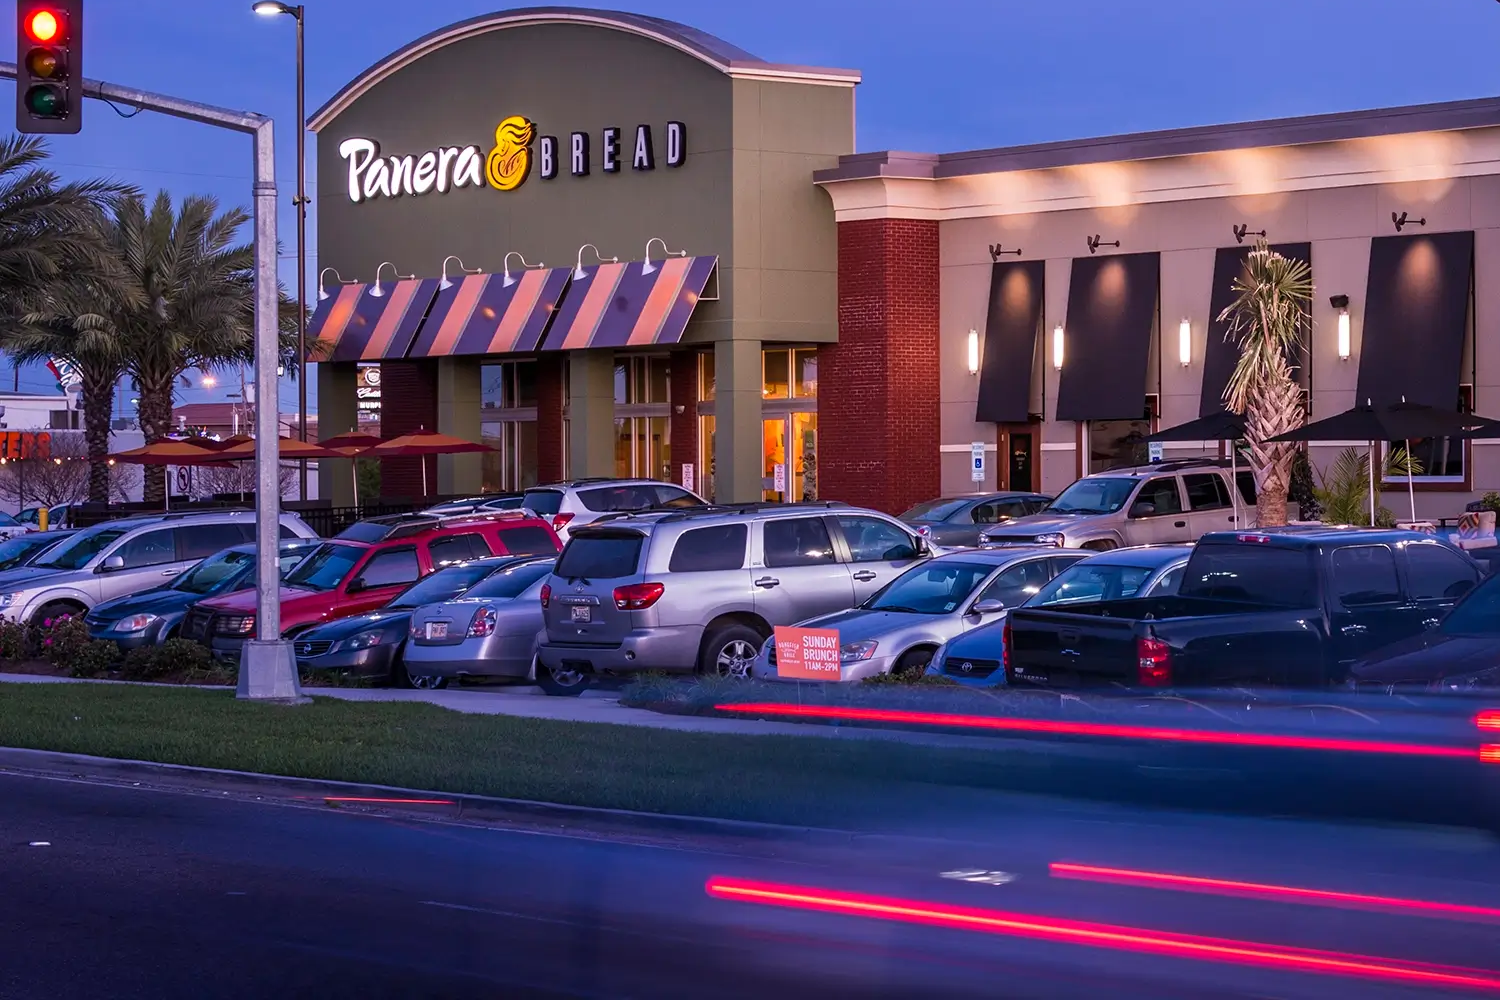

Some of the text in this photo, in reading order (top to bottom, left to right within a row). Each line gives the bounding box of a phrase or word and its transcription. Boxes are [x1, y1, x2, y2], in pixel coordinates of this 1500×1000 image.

[339, 121, 686, 203] Panera BREAD
[803, 636, 836, 648] SUNDAY
[804, 649, 838, 661] BRUNCH
[804, 661, 838, 671] 11AM-2PM
